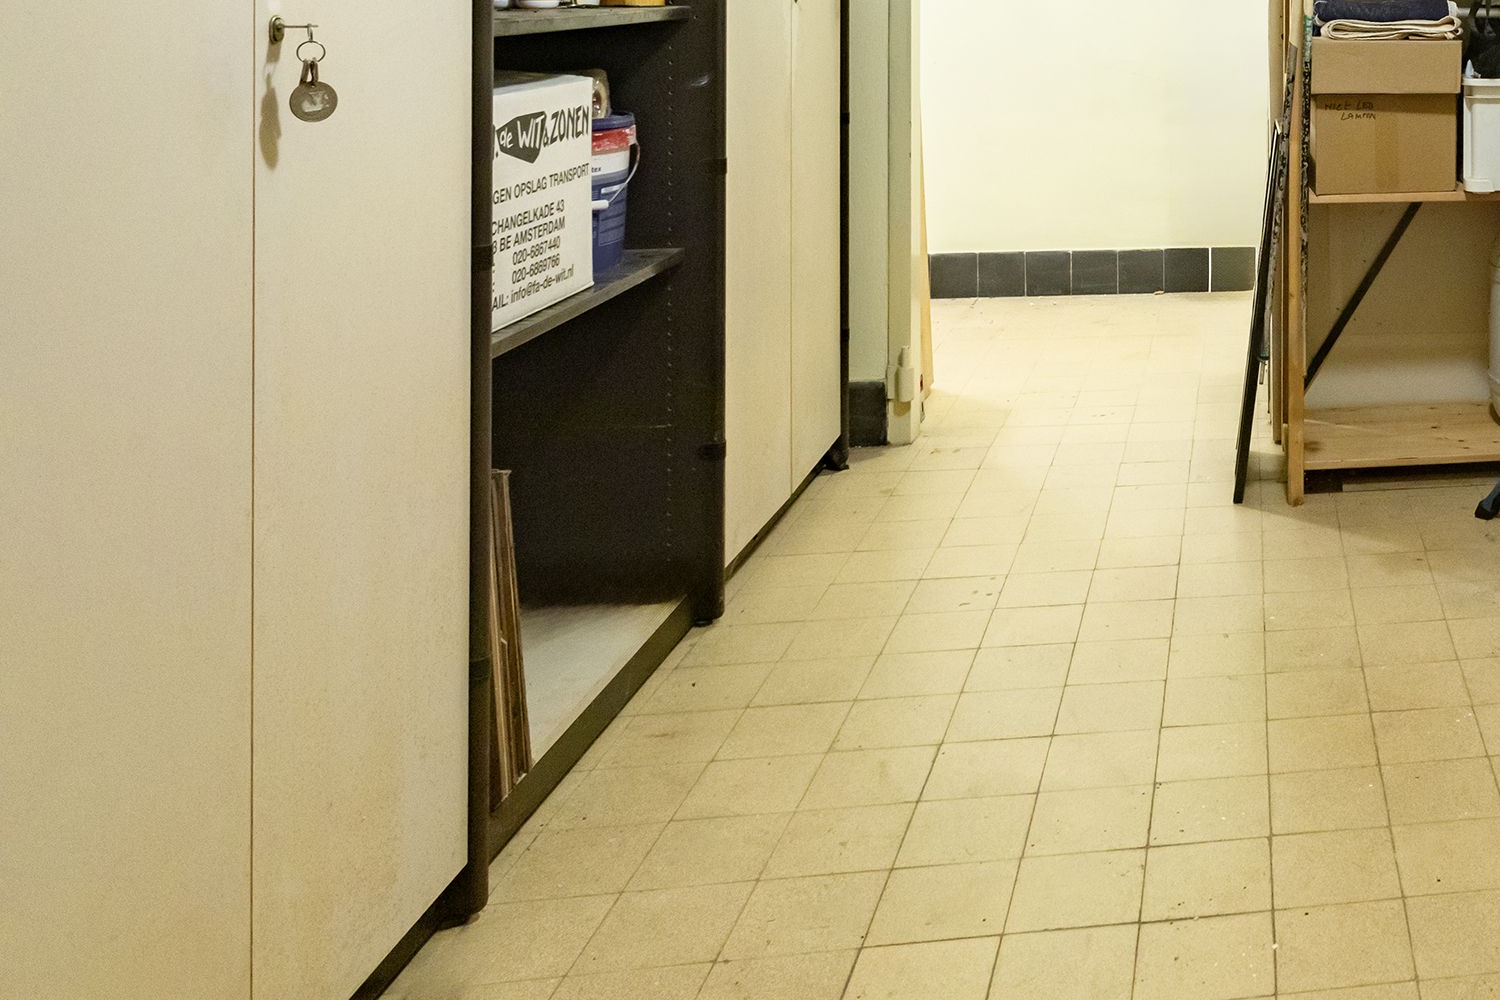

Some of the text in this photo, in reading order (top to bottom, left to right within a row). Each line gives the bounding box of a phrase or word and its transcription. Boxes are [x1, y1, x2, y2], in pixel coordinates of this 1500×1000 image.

[500, 128, 513, 148] de
[516, 114, 545, 149] WIT
[550, 105, 589, 144] ZONEN
[514, 176, 547, 198] OPSLAG
[549, 163, 589, 187] TRANSPORT
[556, 200, 564, 214] 43
[500, 235, 512, 252] BE
[513, 216, 565, 247] AMSTERDAM
[510, 264, 574, 304] info@fa-de-wit.nl
